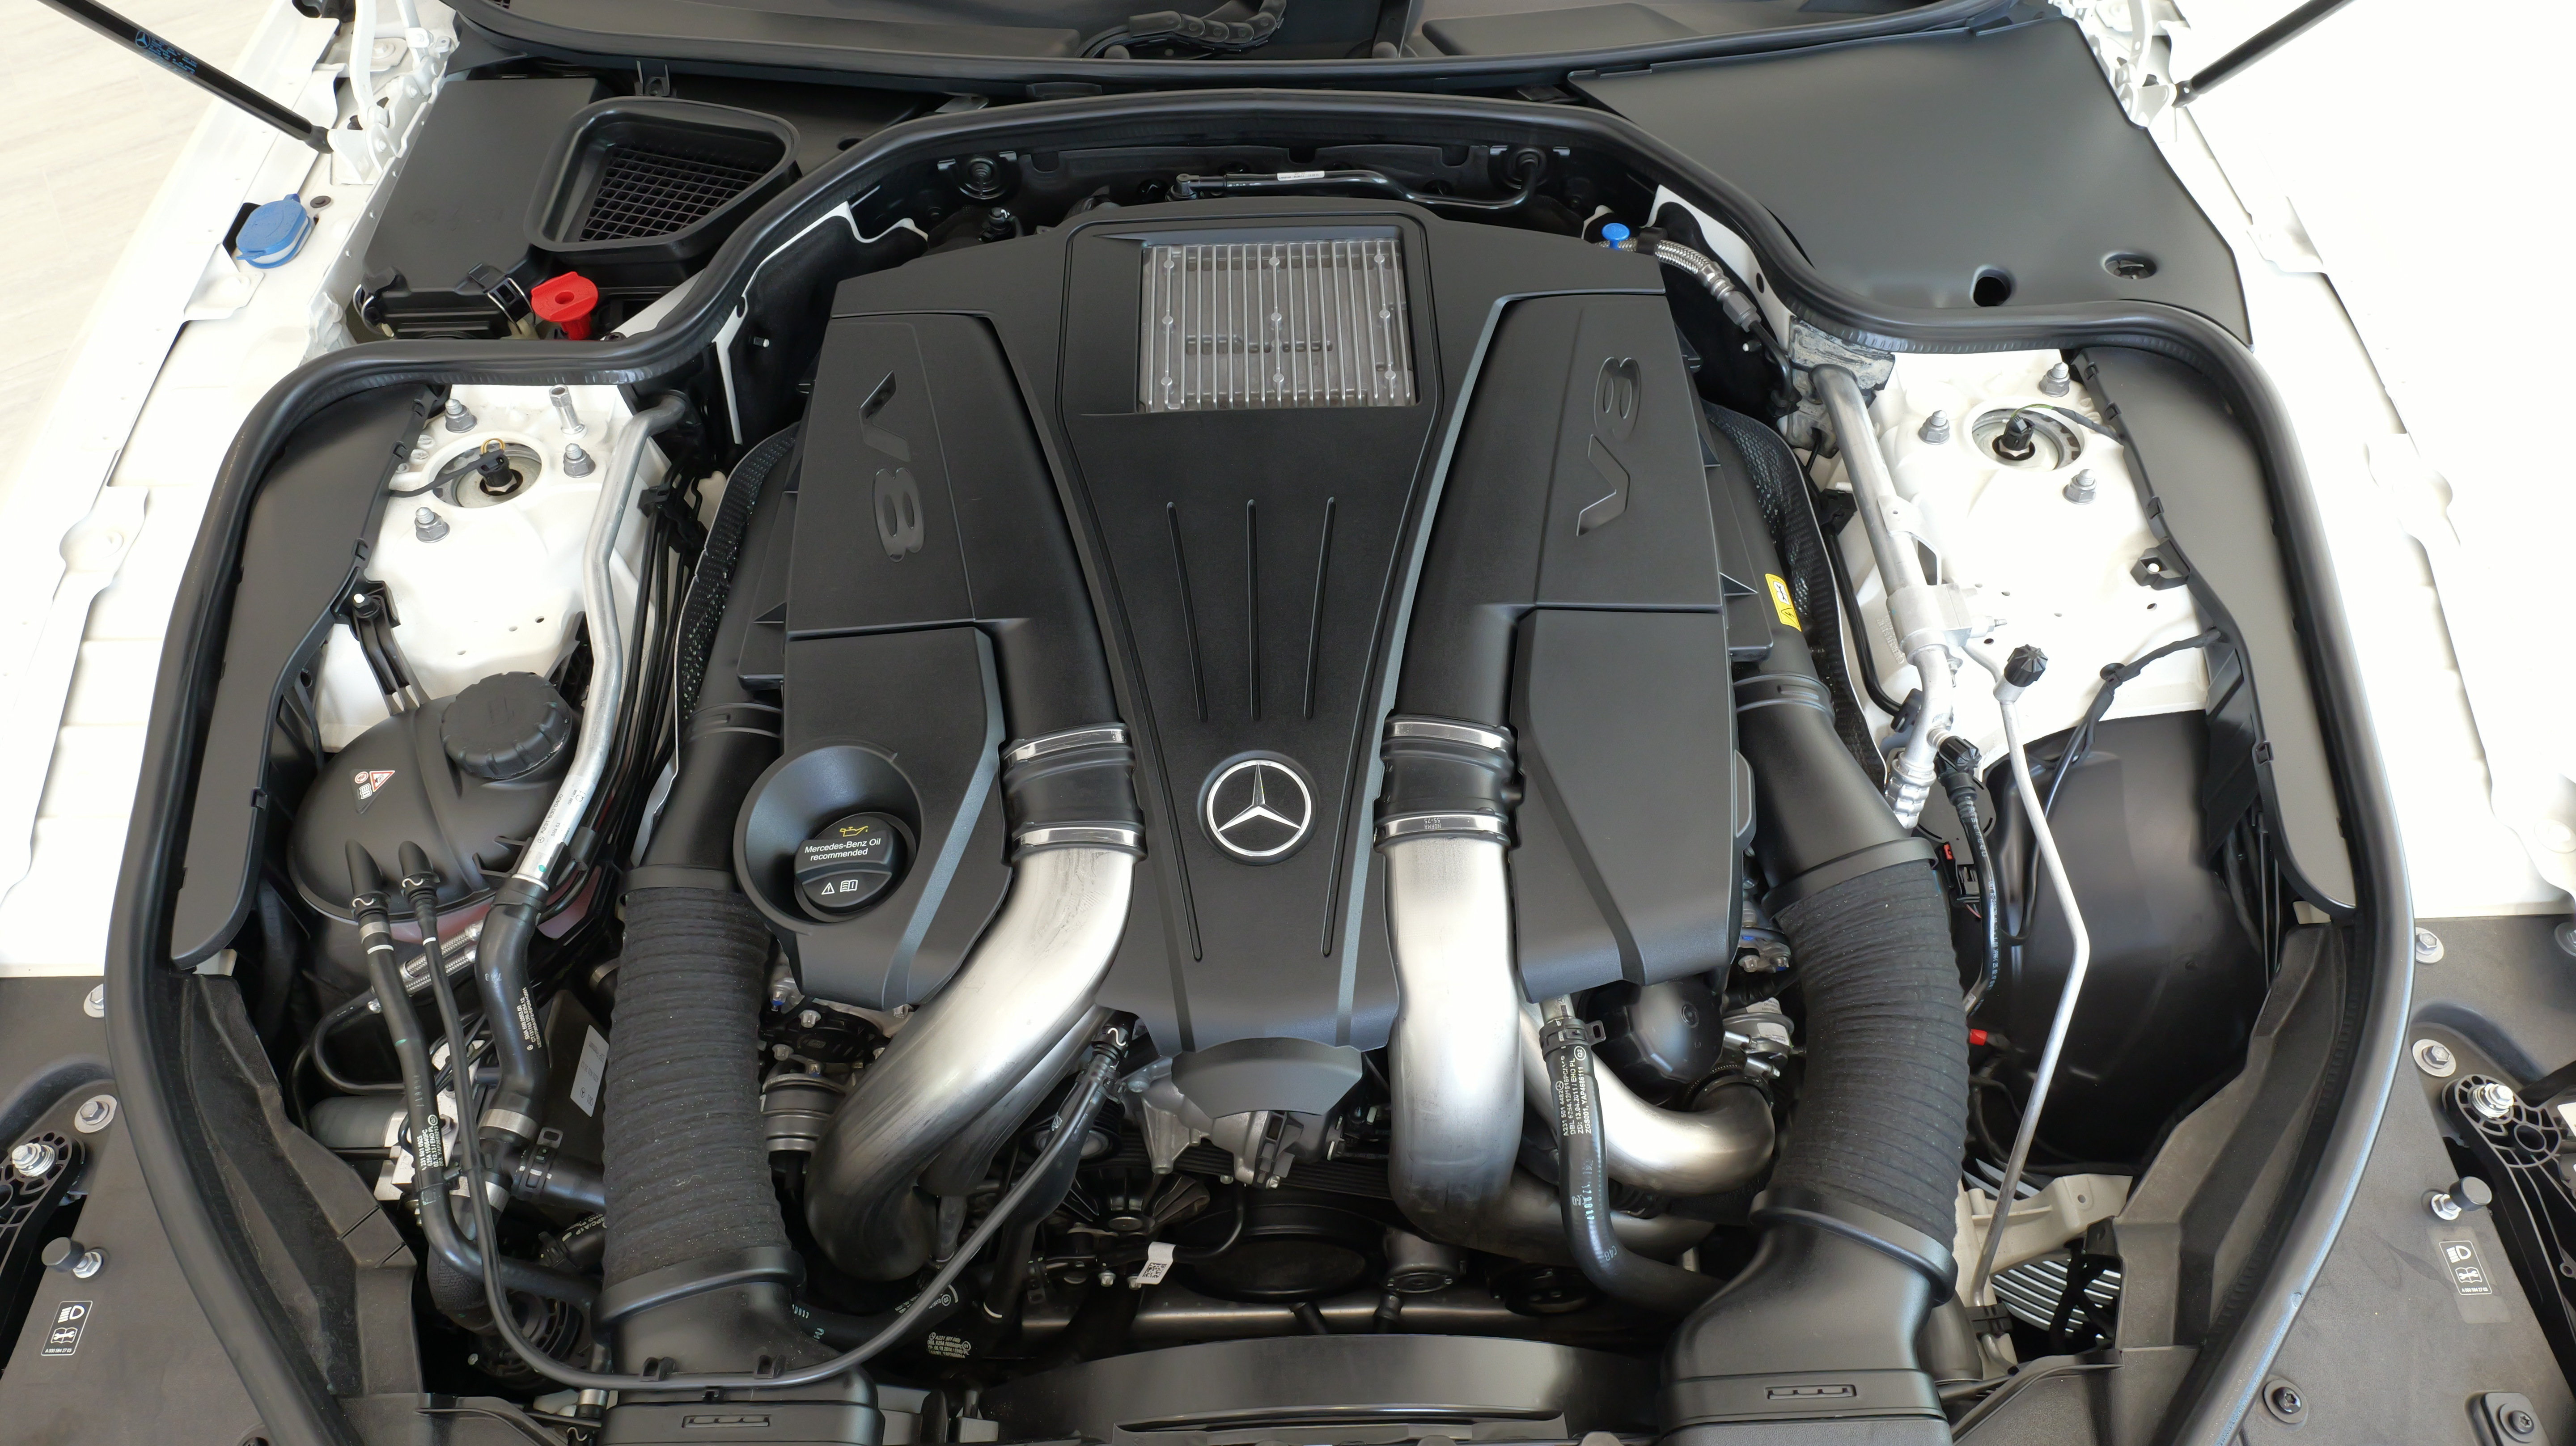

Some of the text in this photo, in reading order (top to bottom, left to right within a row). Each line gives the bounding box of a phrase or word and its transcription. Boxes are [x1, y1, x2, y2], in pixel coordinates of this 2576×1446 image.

[1576, 356, 1642, 537] V8
[858, 369, 925, 562] V8
[805, 838, 881, 853] Mercedes-Benz Oil
[810, 848, 868, 861] recommended
[1569, 1057, 1576, 1067] PL
[1571, 1086, 1582, 1120] 13.04.2011
[1568, 1119, 1576, 1135] DBL
[1584, 1105, 1592, 1134] ZGS001,
[431, 1147, 439, 1167] 02.12.13
